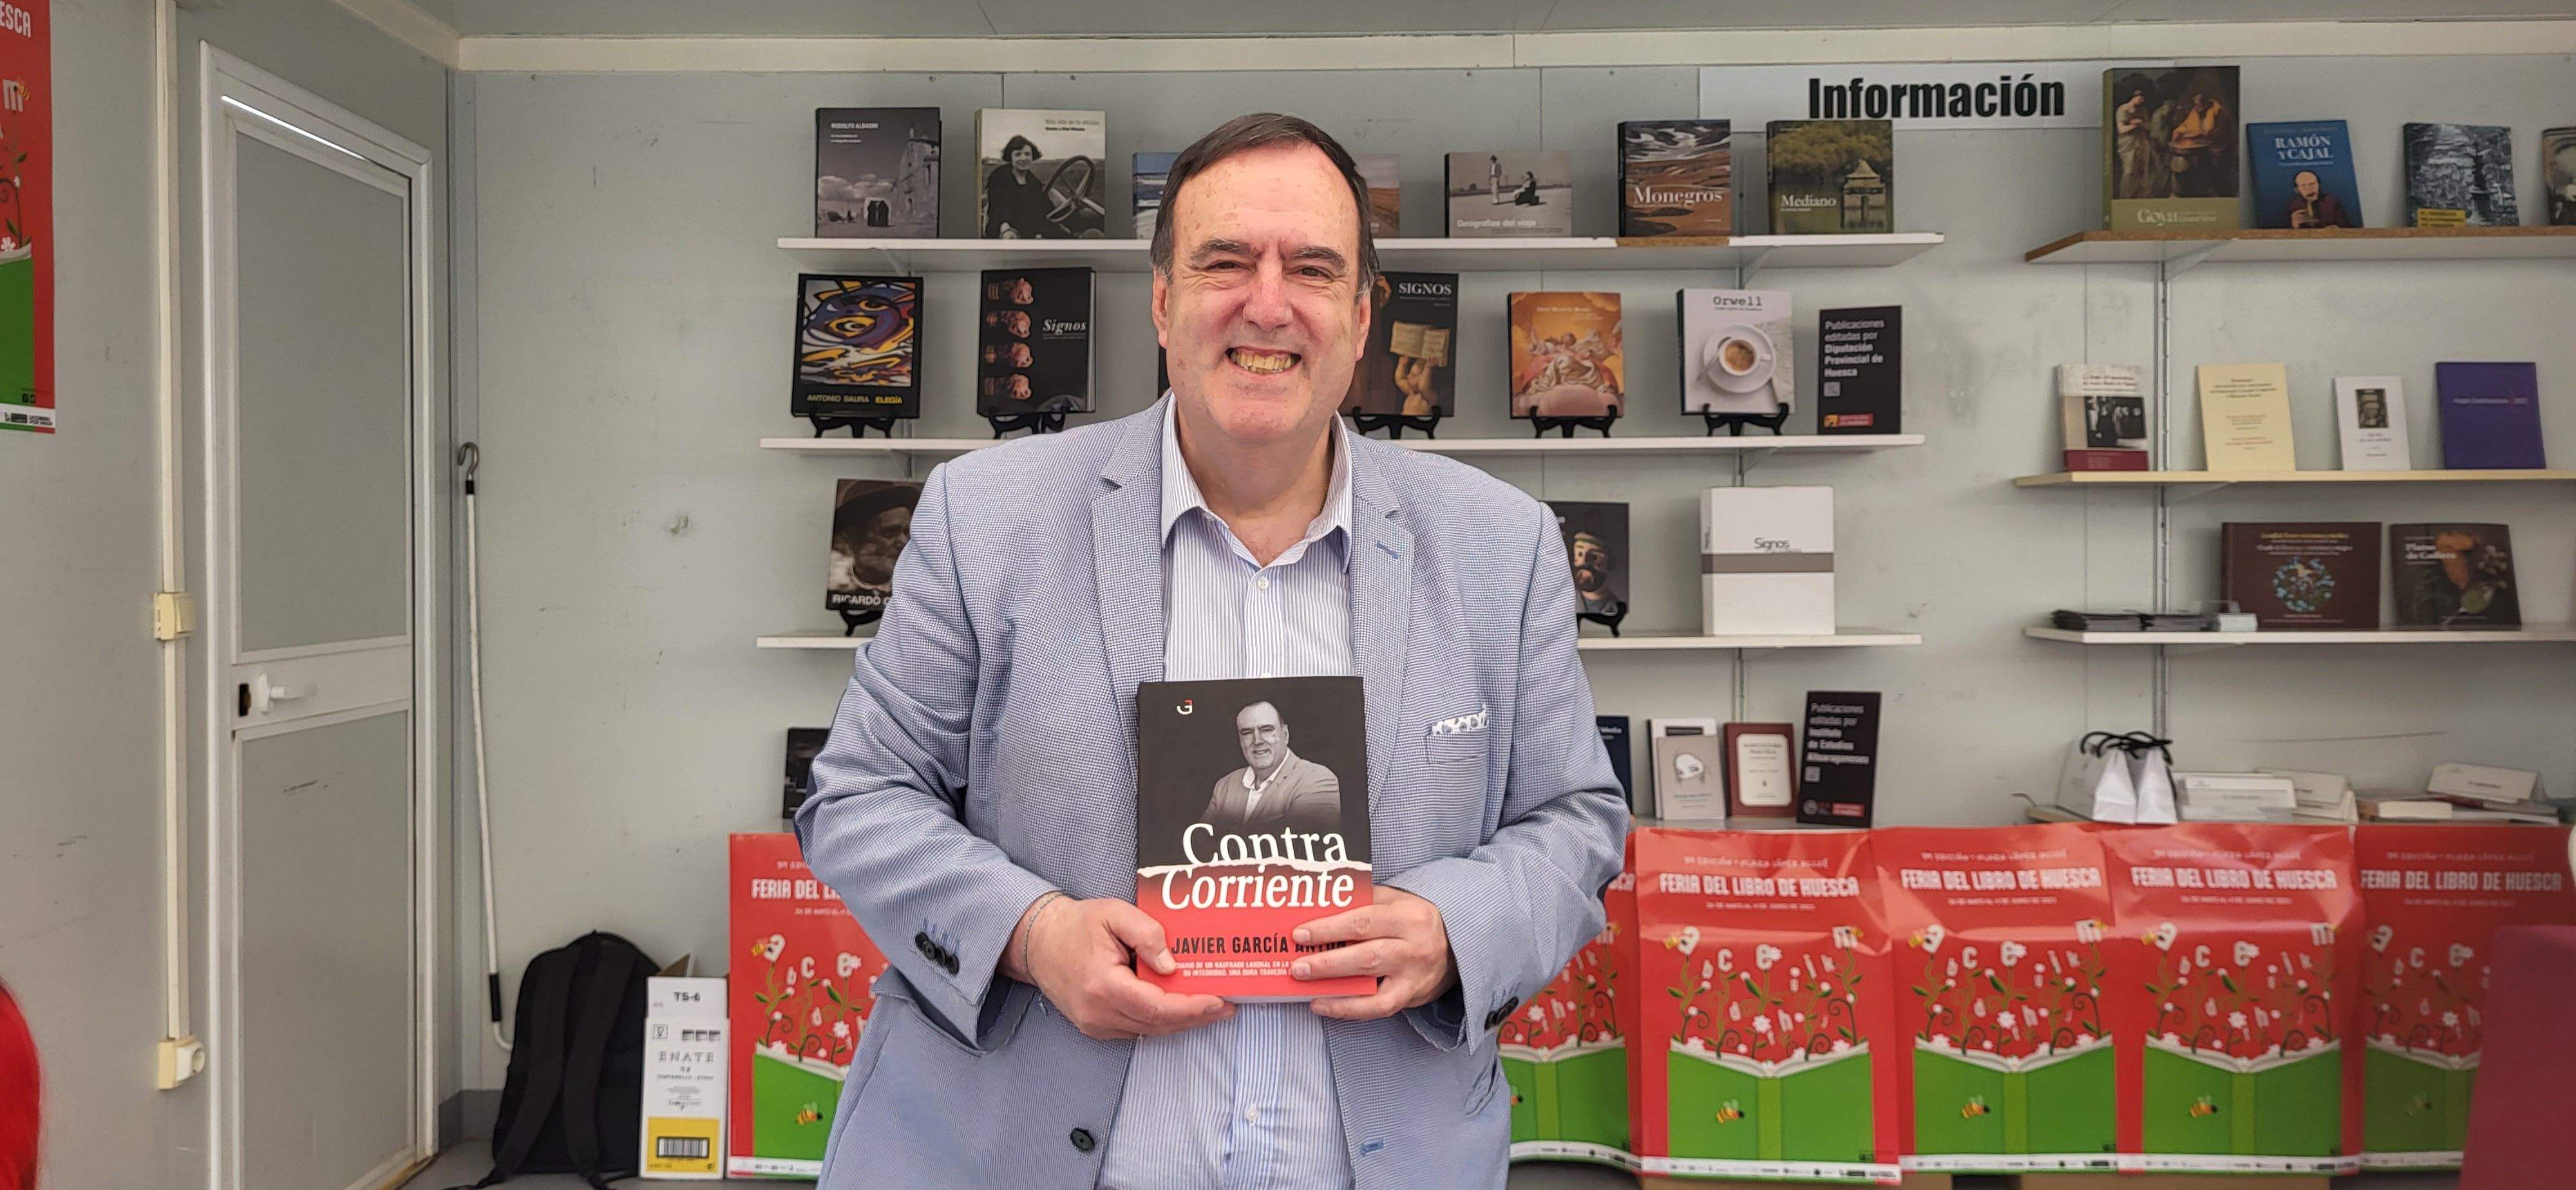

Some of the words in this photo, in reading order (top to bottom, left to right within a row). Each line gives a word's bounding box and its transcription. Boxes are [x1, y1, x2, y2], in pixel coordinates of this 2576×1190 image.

[1809, 73, 2065, 118] Información
[2275, 133, 2331, 149] RAMÓN
[1634, 185, 1723, 207] Monegros
[1781, 194, 1837, 207] Mediano
[1399, 282, 1452, 295] SIGNOS
[1713, 296, 1762, 306] Orwell
[1042, 319, 1086, 335] Signos
[1824, 320, 1884, 330] Publicaciones
[1862, 332, 1878, 342] por
[1824, 343, 1873, 354] Diputación
[1824, 355, 1870, 365] Provincial
[1871, 354, 1884, 363] de
[1824, 368, 1858, 377] Huesca
[807, 394, 841, 402] ANTONIO
[833, 594, 881, 605] RICARDO
[1806, 740, 1819, 750] de
[1182, 823, 1349, 865] Contra
[1162, 864, 1354, 910] Corriente
[1660, 873, 1701, 894] FERIA
[1703, 874, 1731, 896] DEL
[1731, 876, 1776, 896] LIBRO
[1777, 878, 1799, 897] DE
[1799, 876, 1860, 898] HUESCA
[1900, 869, 1942, 890] FERIA
[1942, 870, 1971, 891] DEL
[1970, 871, 2016, 891] LIBRO
[2016, 869, 2040, 890] DE
[2039, 867, 2102, 888] HUESCA
[2130, 867, 2174, 887] FERIA
[2174, 868, 2205, 888] DEL
[2204, 869, 2250, 889] LIBRO
[2251, 869, 2274, 889] DE
[2273, 869, 2338, 889] HUESCA
[2360, 870, 2400, 889] FERIA
[2405, 871, 2430, 890] DEL
[2435, 871, 2478, 891] LIBRO
[2483, 872, 2501, 891] DE
[2505, 872, 2562, 892] HUESCA
[752, 878, 791, 900] FERIA
[794, 879, 820, 900] DEL
[1171, 937, 1226, 954] JAVIER
[1232, 933, 1289, 954] GARCÍA
[1717, 949, 1733, 972] c
[1962, 946, 1978, 968] c
[2195, 945, 2211, 967] c
[2410, 947, 2424, 968] c
[800, 956, 815, 979] c
[659, 1050, 714, 1062] ENATE
